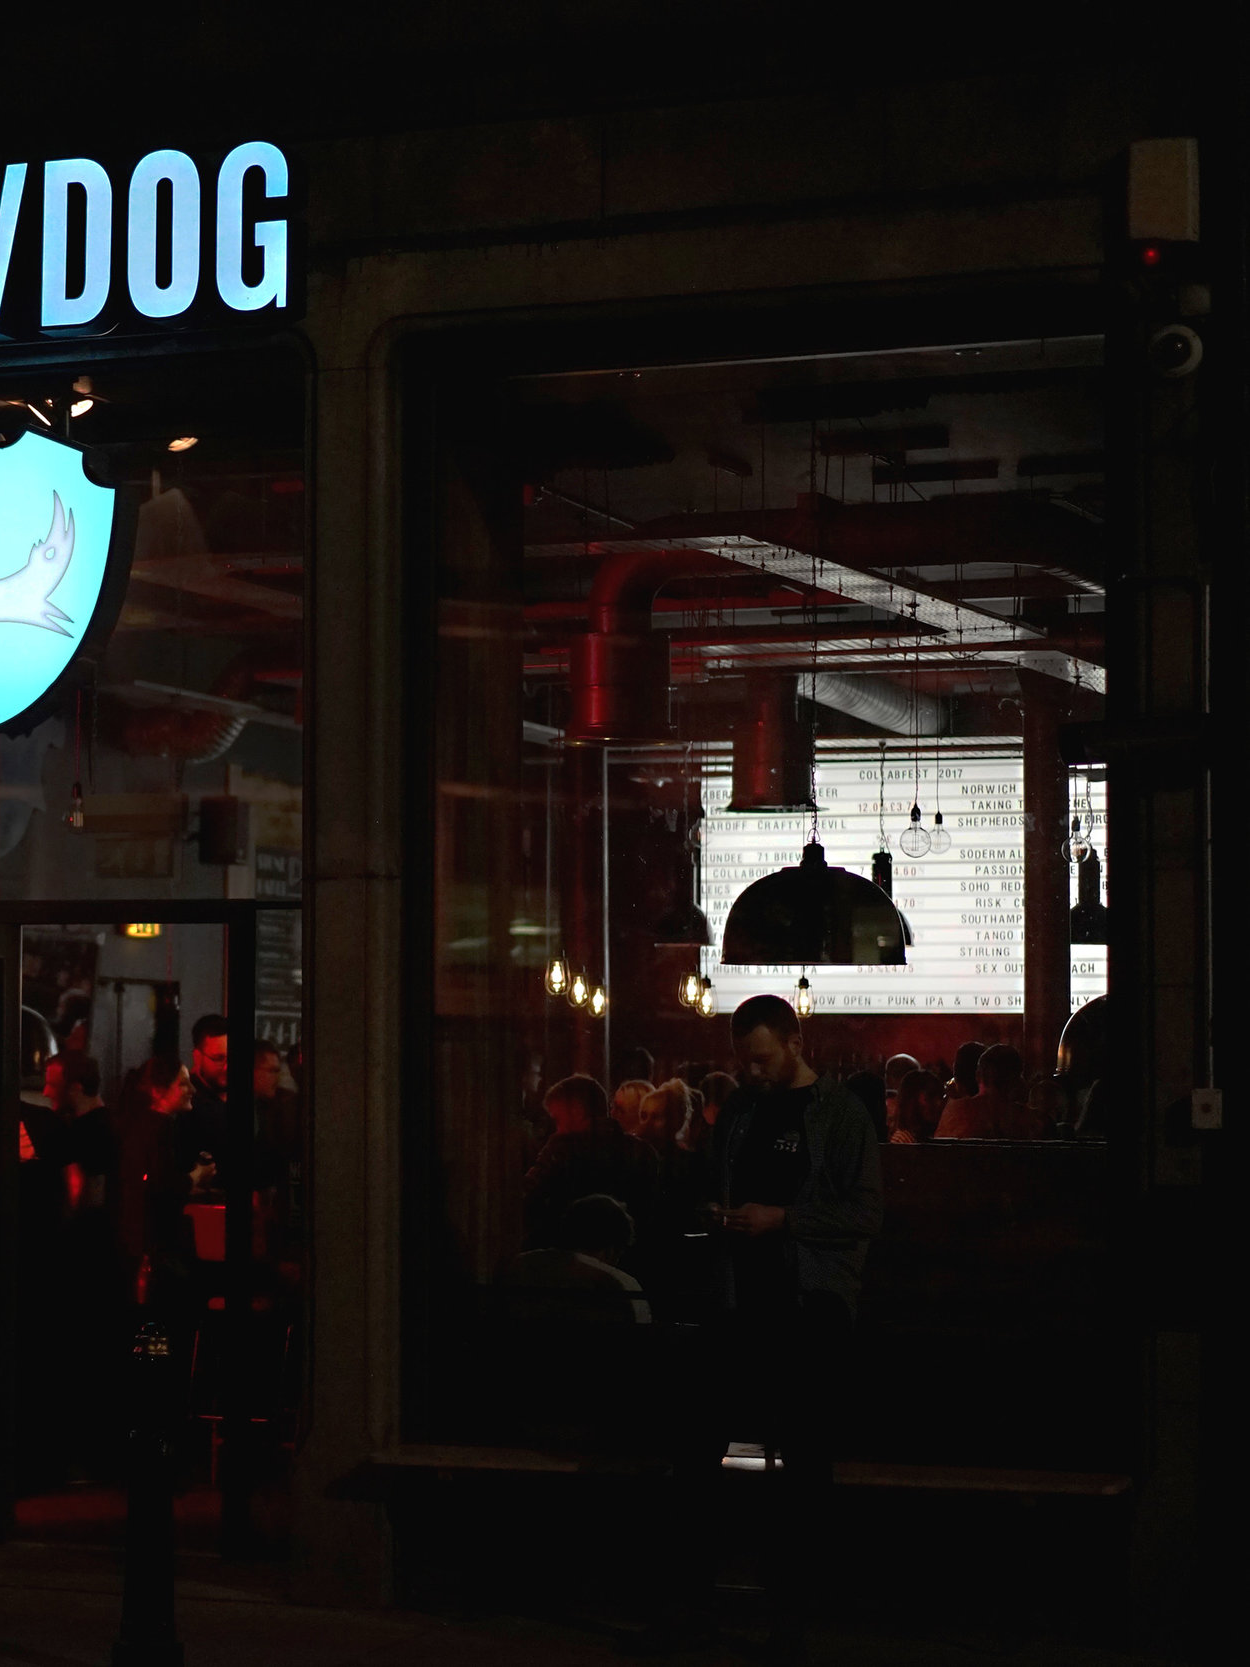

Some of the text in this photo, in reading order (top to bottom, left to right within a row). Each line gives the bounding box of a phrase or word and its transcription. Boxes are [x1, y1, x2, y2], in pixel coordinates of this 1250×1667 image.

[859, 768, 964, 780] COLABFEST 2017
[961, 784, 1017, 795] NORWICH
[970, 799, 1013, 810] TAKING
[757, 819, 801, 830] CRAFTY
[957, 816, 1025, 827] SHEPHERDS
[960, 881, 990, 892] SOHO
[975, 930, 1014, 941] TANGO
[959, 946, 1011, 957] STIRLING
[713, 964, 751, 975] HIGHER
[975, 963, 998, 974] SEX
[843, 995, 872, 1006] OPEN
[887, 995, 916, 1006] PUNK
[925, 995, 944, 1006] IPA
[953, 995, 962, 1006] &
[973, 995, 1001, 1006] TWO
